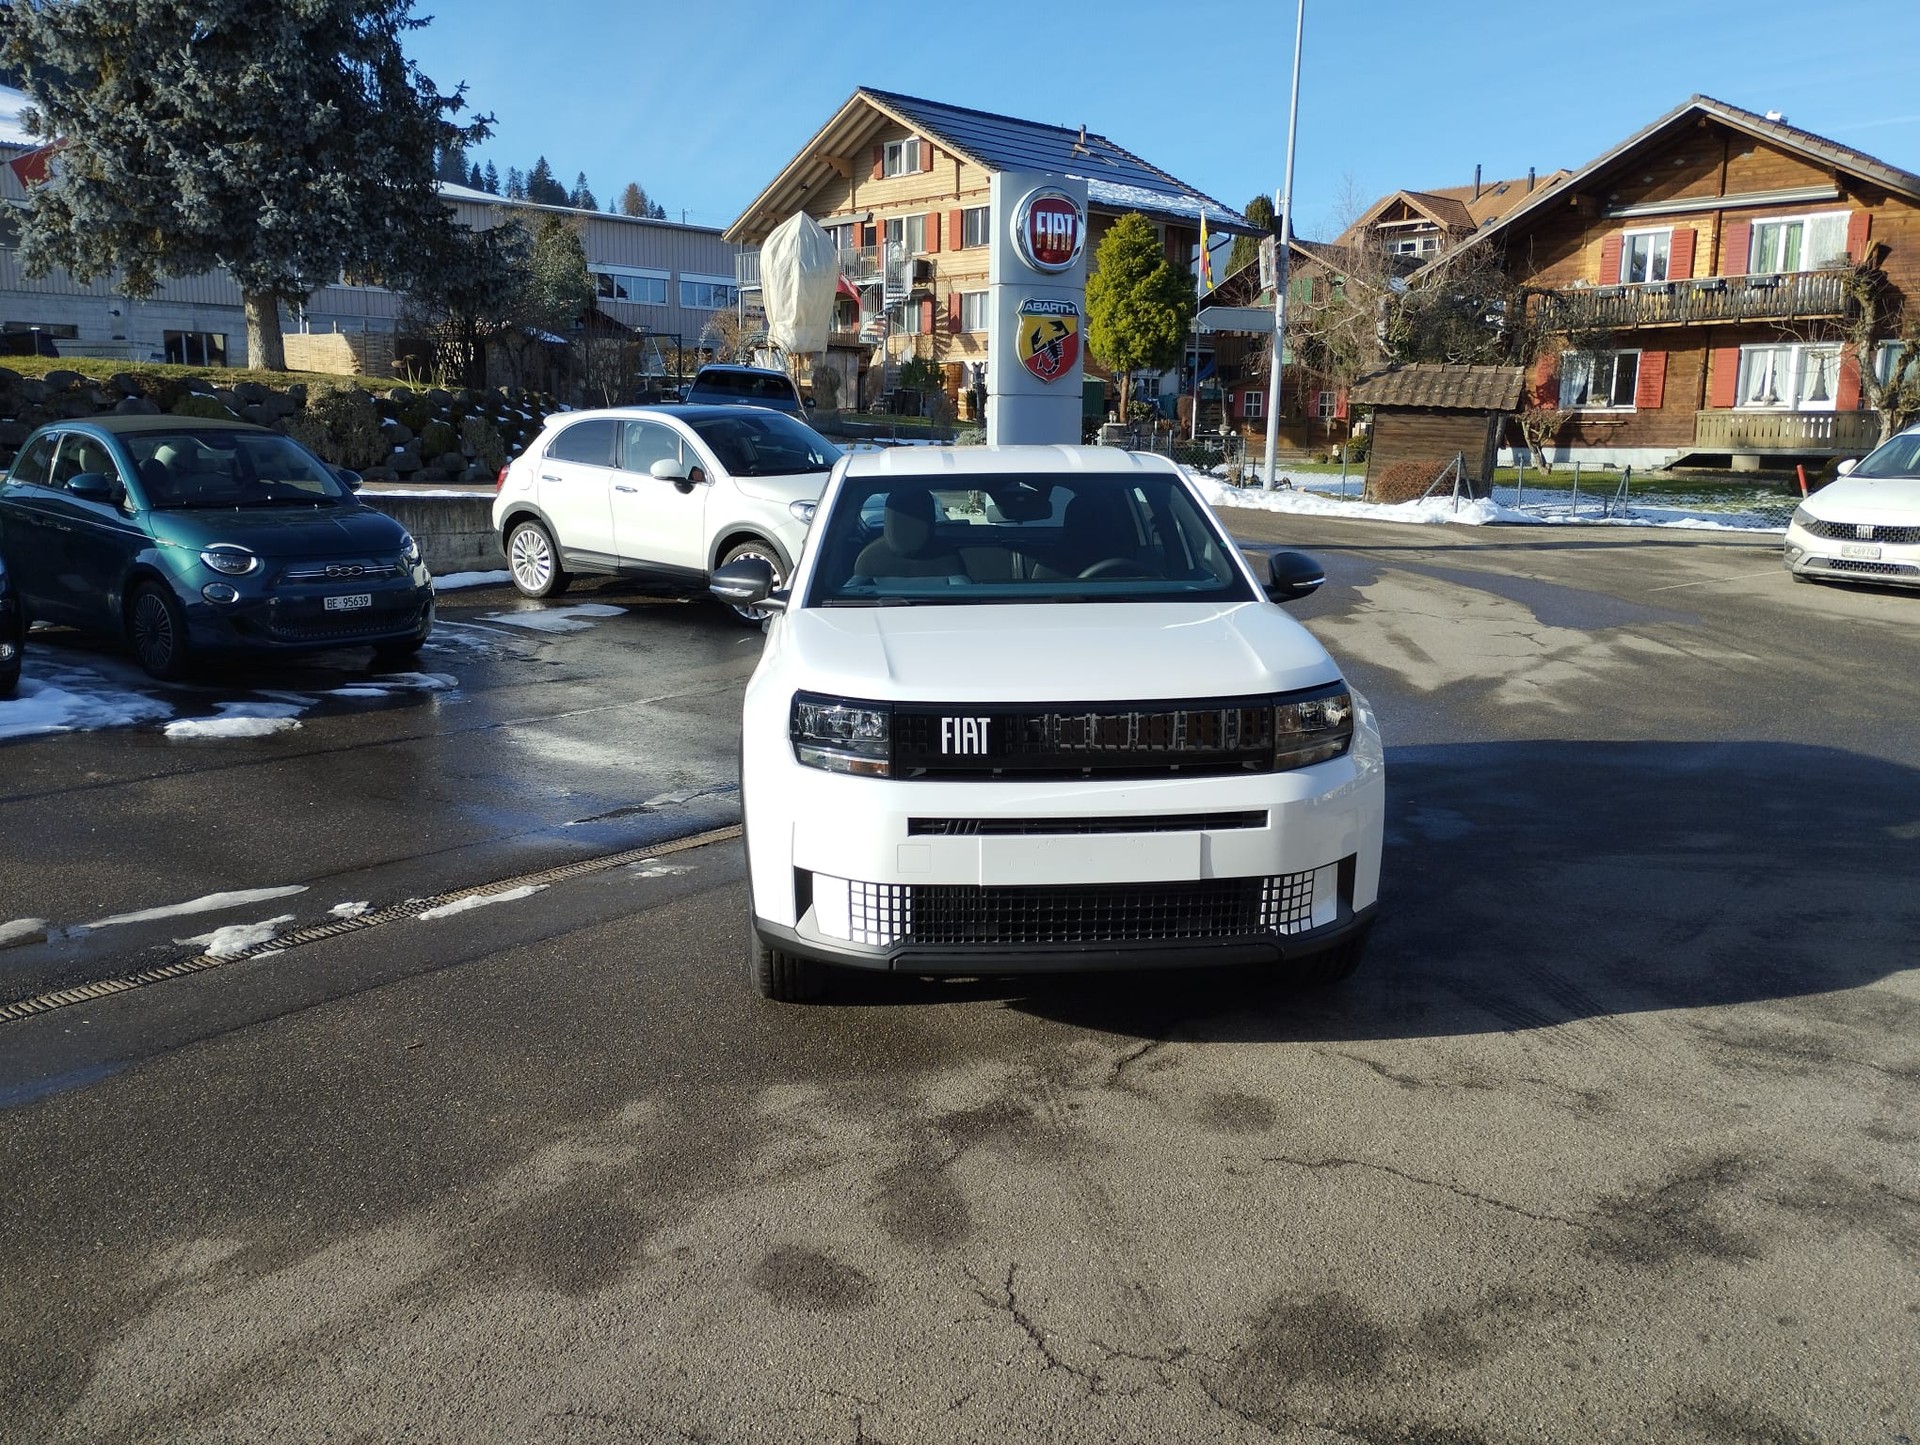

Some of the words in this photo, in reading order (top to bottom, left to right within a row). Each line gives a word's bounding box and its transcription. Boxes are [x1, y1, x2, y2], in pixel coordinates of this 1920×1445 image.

[1036, 211, 1073, 251] FIAT
[1024, 302, 1075, 314] ABARTH
[1856, 524, 1875, 539] FIAT
[326, 565, 363, 577] 500
[343, 595, 369, 607] 95639
[941, 717, 991, 755] FIAT
